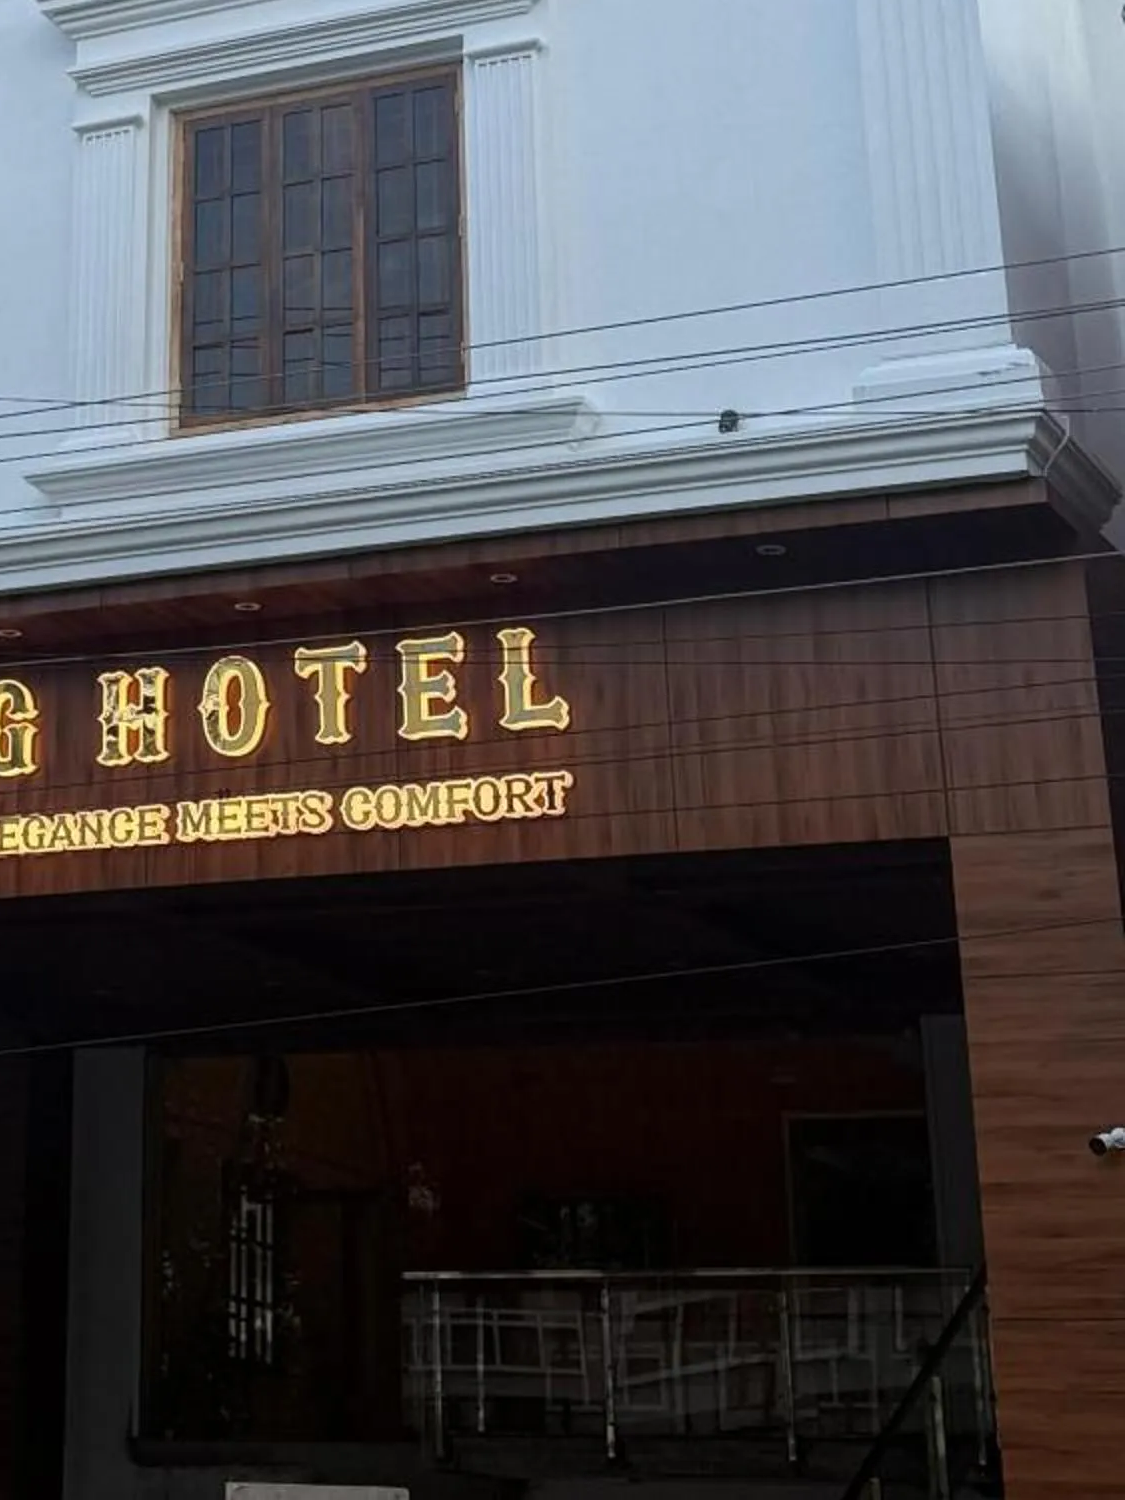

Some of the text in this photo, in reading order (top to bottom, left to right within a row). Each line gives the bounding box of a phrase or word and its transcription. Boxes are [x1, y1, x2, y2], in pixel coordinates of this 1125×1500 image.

[95, 627, 571, 767] HOTEL
[176, 789, 334, 844] MEETS
[340, 770, 574, 832] COMFORT
